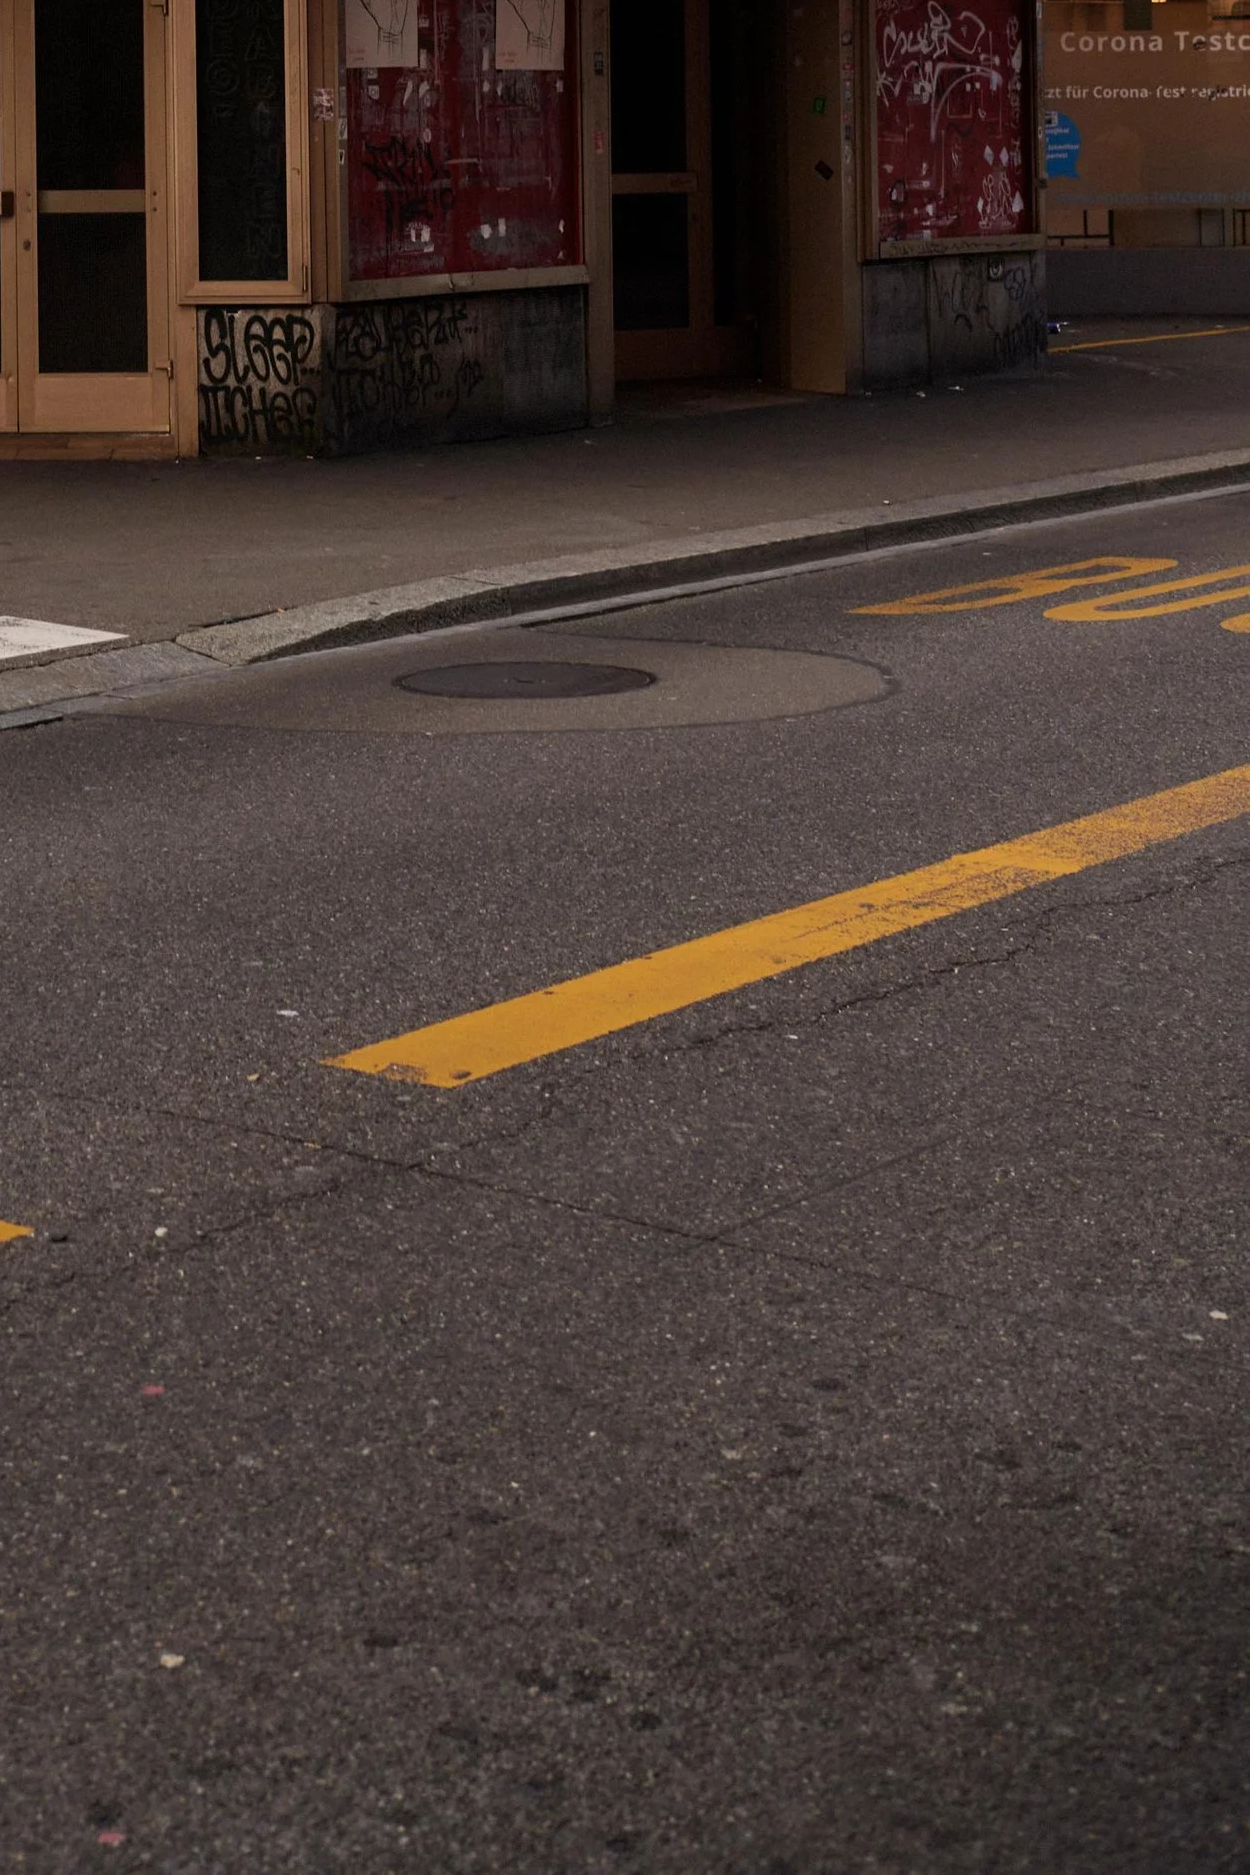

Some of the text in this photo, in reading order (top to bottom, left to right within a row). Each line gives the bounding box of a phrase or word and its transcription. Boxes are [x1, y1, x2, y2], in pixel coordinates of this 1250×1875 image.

[1060, 31, 1163, 53] Corona
[1065, 84, 1088, 99] für
[847, 555, 1250, 633] BU
